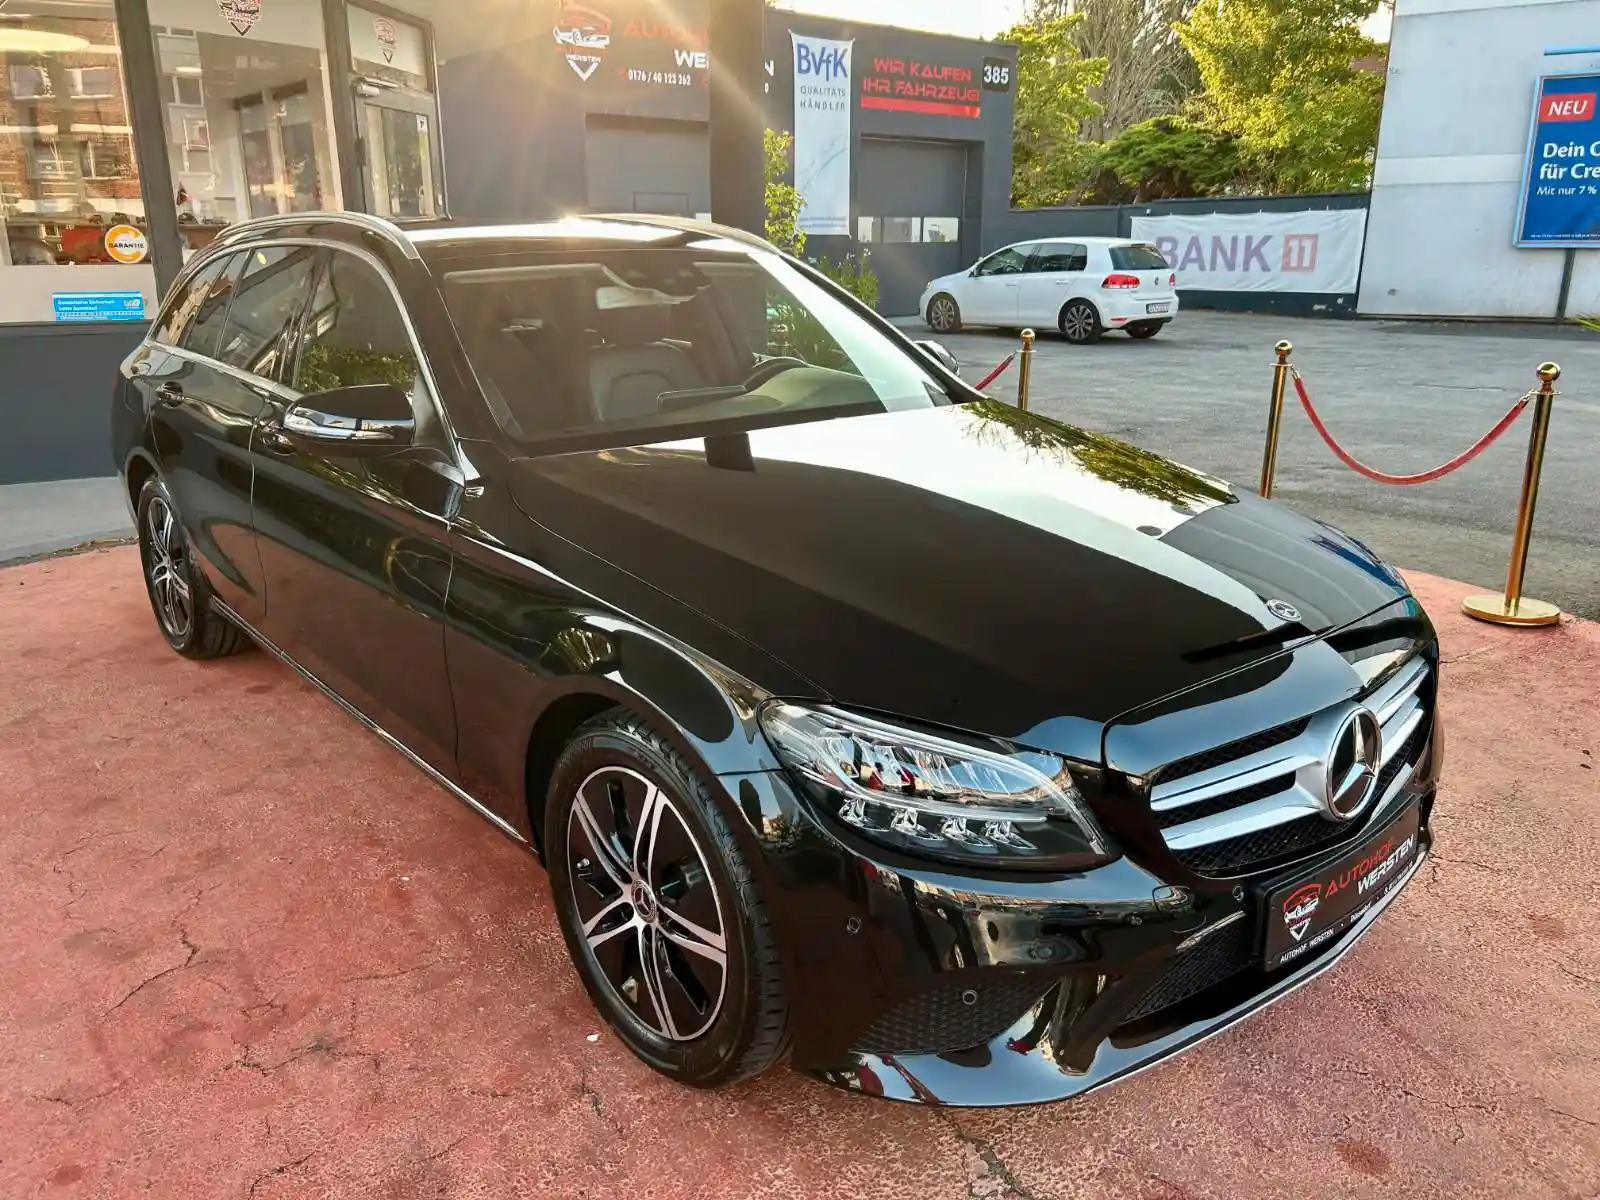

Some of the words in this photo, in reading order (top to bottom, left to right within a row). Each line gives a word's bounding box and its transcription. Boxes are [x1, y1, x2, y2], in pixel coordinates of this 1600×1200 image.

[797, 43, 848, 82] BVfK
[873, 57, 905, 76] WIR
[910, 61, 972, 82] KAUFEN
[628, 68, 647, 82] 0176
[653, 71, 662, 83] 40
[664, 73, 677, 85] 123
[678, 74, 692, 86] 262
[983, 65, 1010, 85] 385
[862, 76, 891, 94] IHR
[1548, 100, 1588, 116] NEU
[1542, 142, 1585, 158] Dein
[1539, 163, 1568, 180] für
[1537, 186, 1556, 196] Mit
[1557, 187, 1576, 196] nur
[1579, 186, 1586, 195] 7
[1587, 186, 1597, 195] %
[1155, 234, 1273, 272] BANK
[1288, 239, 1312, 267] 11
[1357, 833, 1414, 895] WERSTEN
[1279, 942, 1309, 964] AUTOHOF
